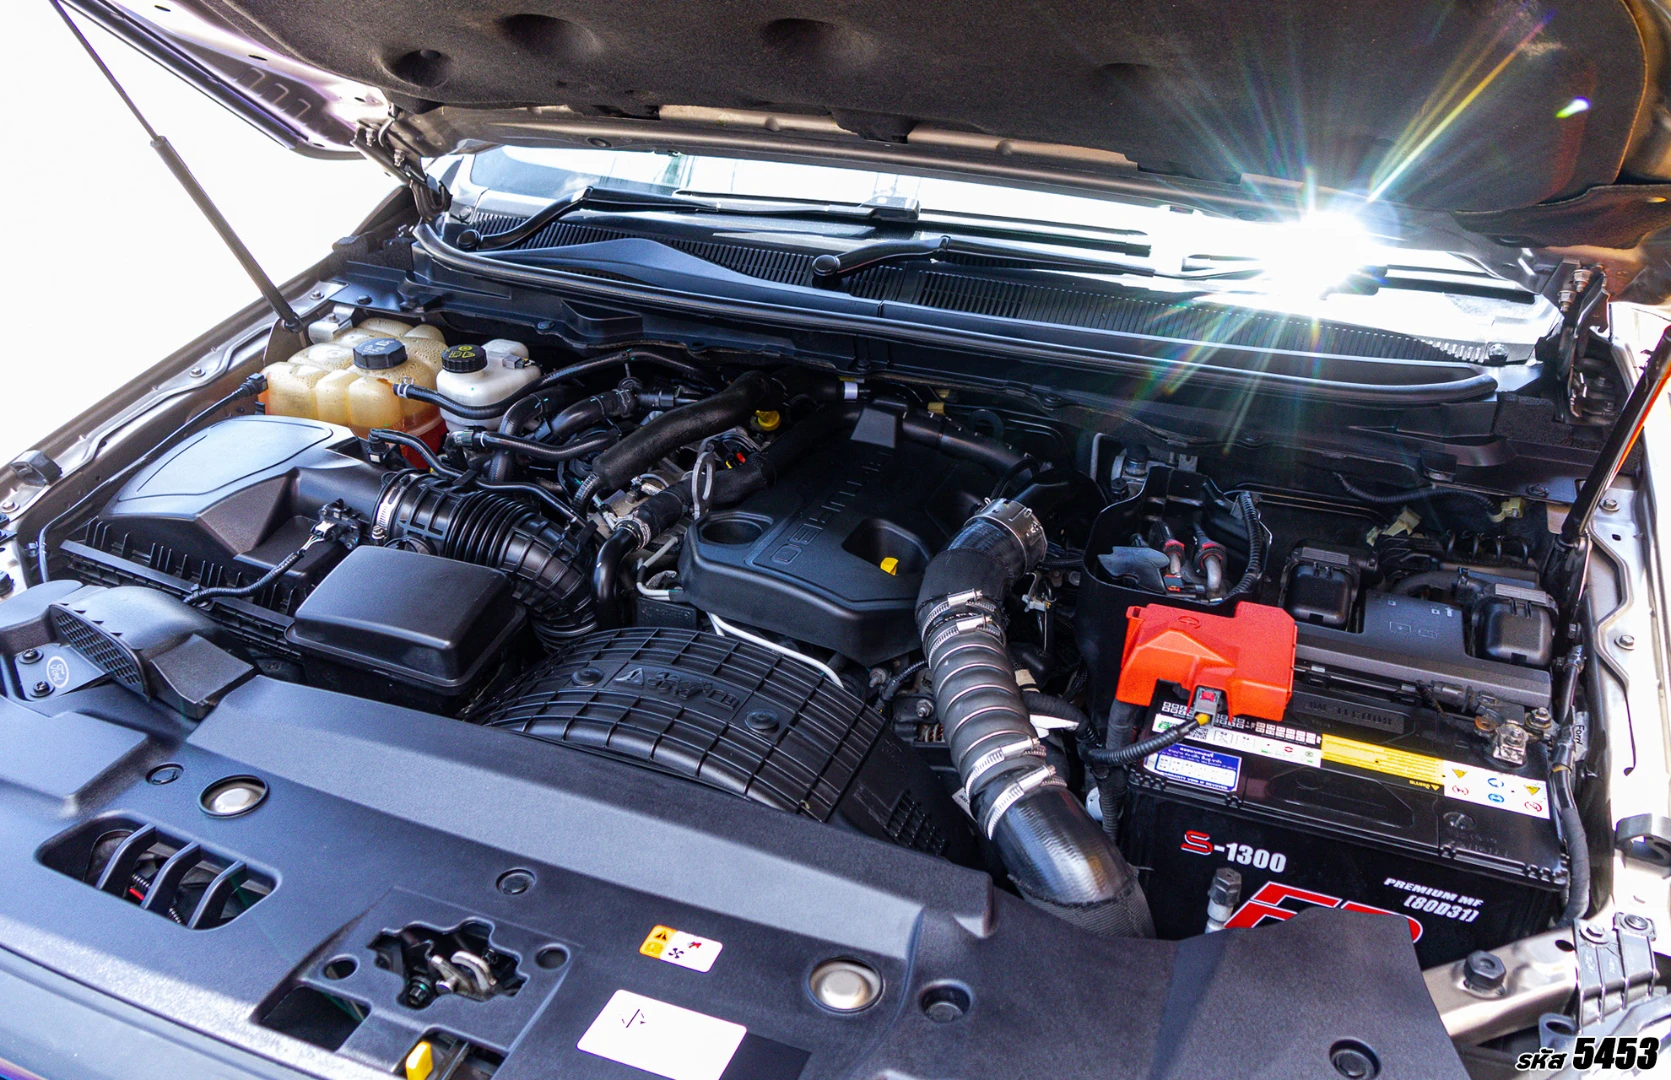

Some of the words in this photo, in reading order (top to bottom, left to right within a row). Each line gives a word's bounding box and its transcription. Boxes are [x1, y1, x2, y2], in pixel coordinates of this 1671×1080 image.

[1574, 724, 1585, 745] Ford
[1180, 829, 1287, 873] S-1300
[1383, 877, 1458, 902] PREMIUM
[1457, 895, 1484, 908] MF
